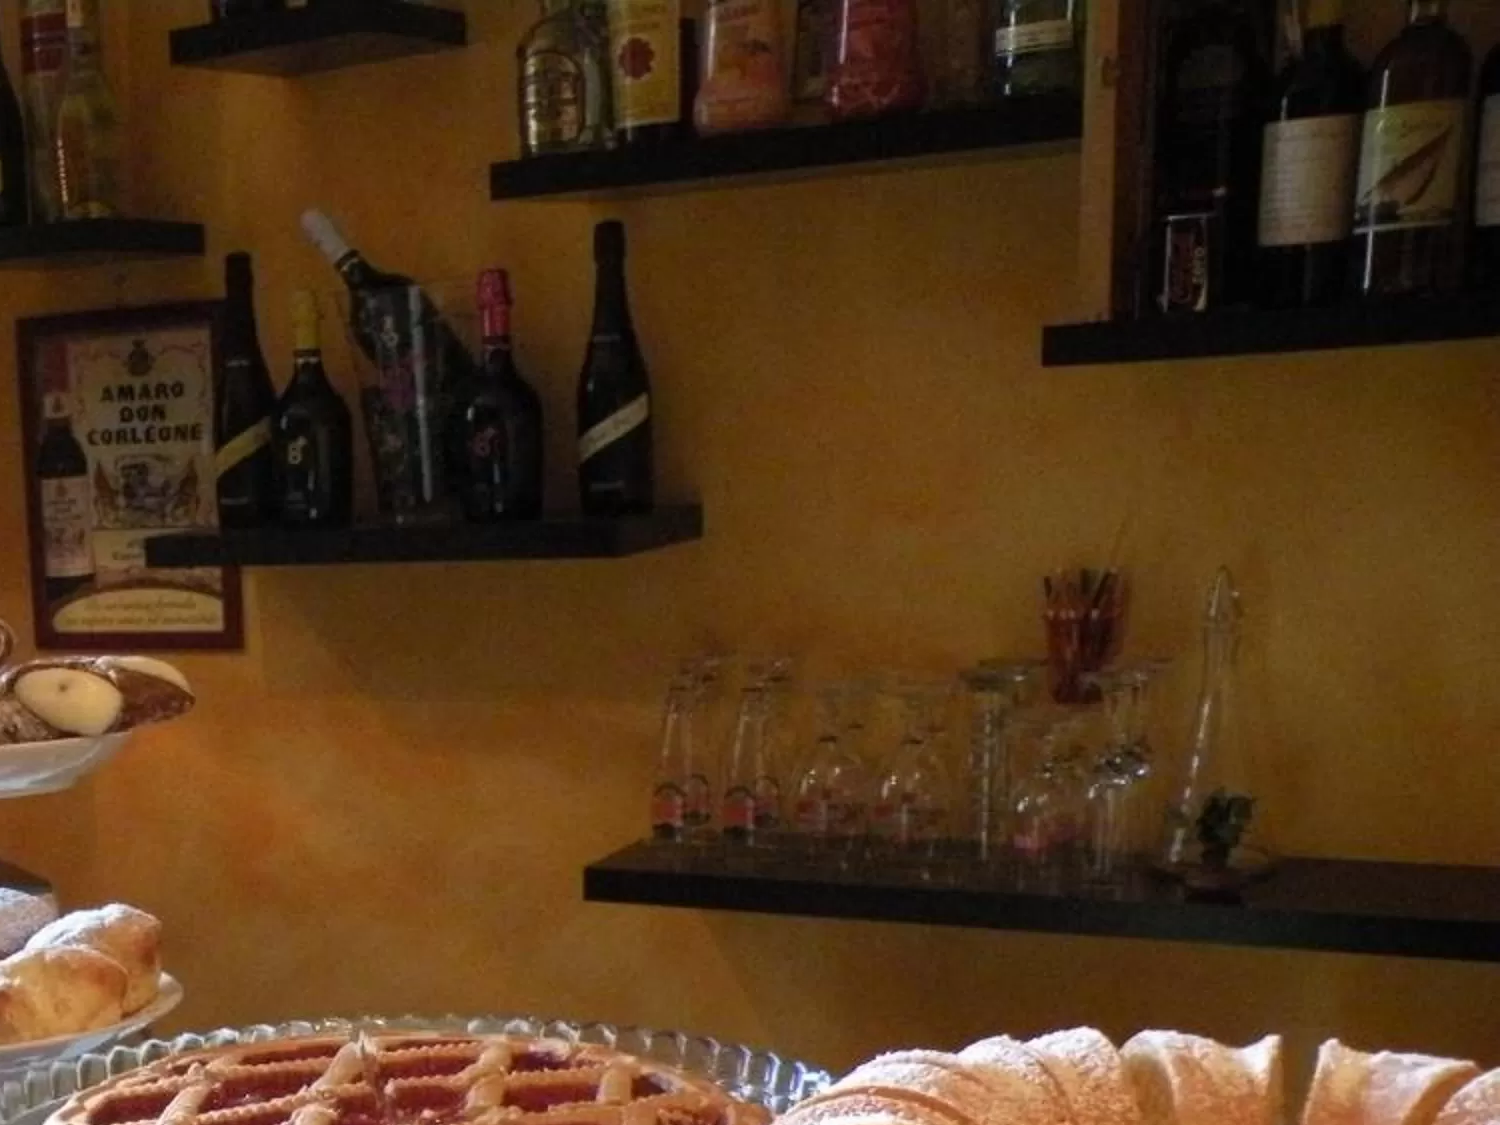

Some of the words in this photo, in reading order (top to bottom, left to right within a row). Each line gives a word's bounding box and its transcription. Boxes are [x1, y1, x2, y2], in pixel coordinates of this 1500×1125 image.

[101, 381, 185, 402] AMARO
[119, 404, 167, 423] DON
[86, 423, 205, 446] CORLEONE
